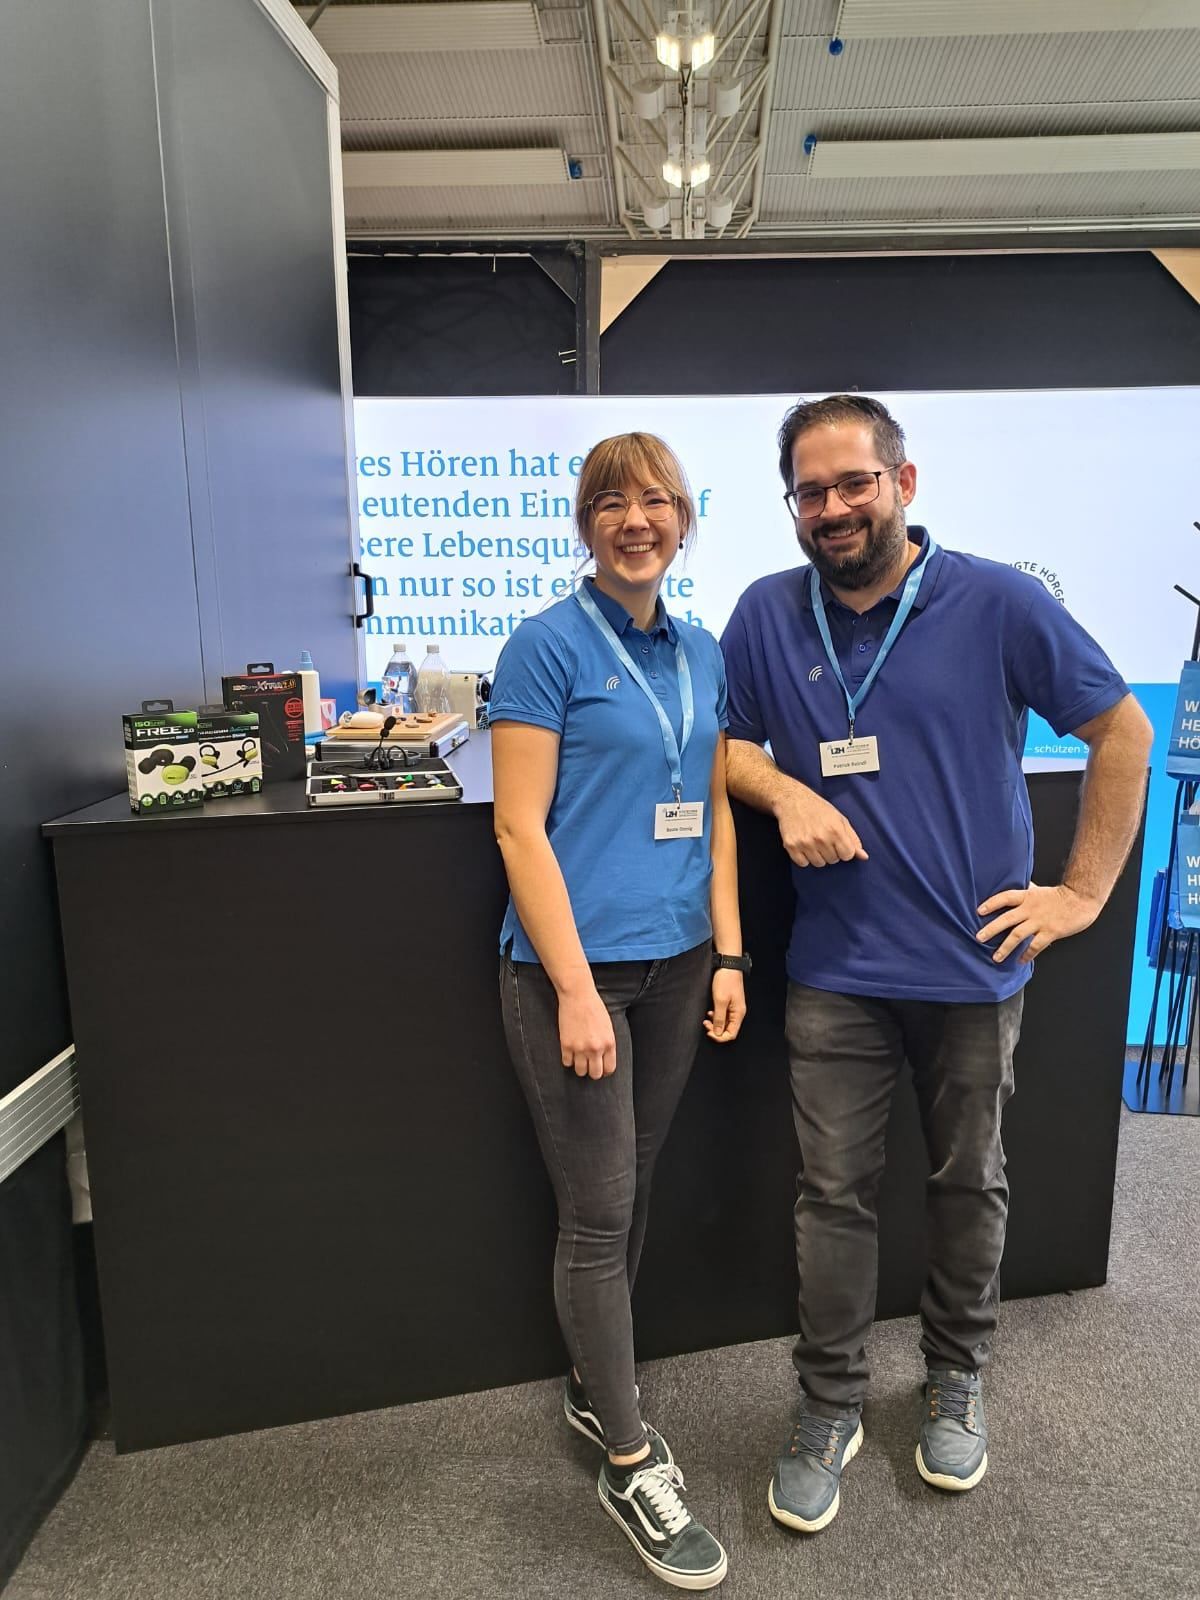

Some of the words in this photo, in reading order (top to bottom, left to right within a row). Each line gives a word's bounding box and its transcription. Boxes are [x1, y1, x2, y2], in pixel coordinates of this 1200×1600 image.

[400, 449, 500, 477] Hören
[509, 448, 560, 477] hat
[359, 489, 511, 518] eutenden
[399, 577, 454, 597] nur
[462, 577, 496, 597] so
[505, 569, 543, 597] ist
[661, 574, 694, 597] te
[136, 726, 183, 737] FREE
[1034, 745, 1081, 753] schützen
[1187, 874, 1200, 887] H
[1188, 892, 1200, 905] H
